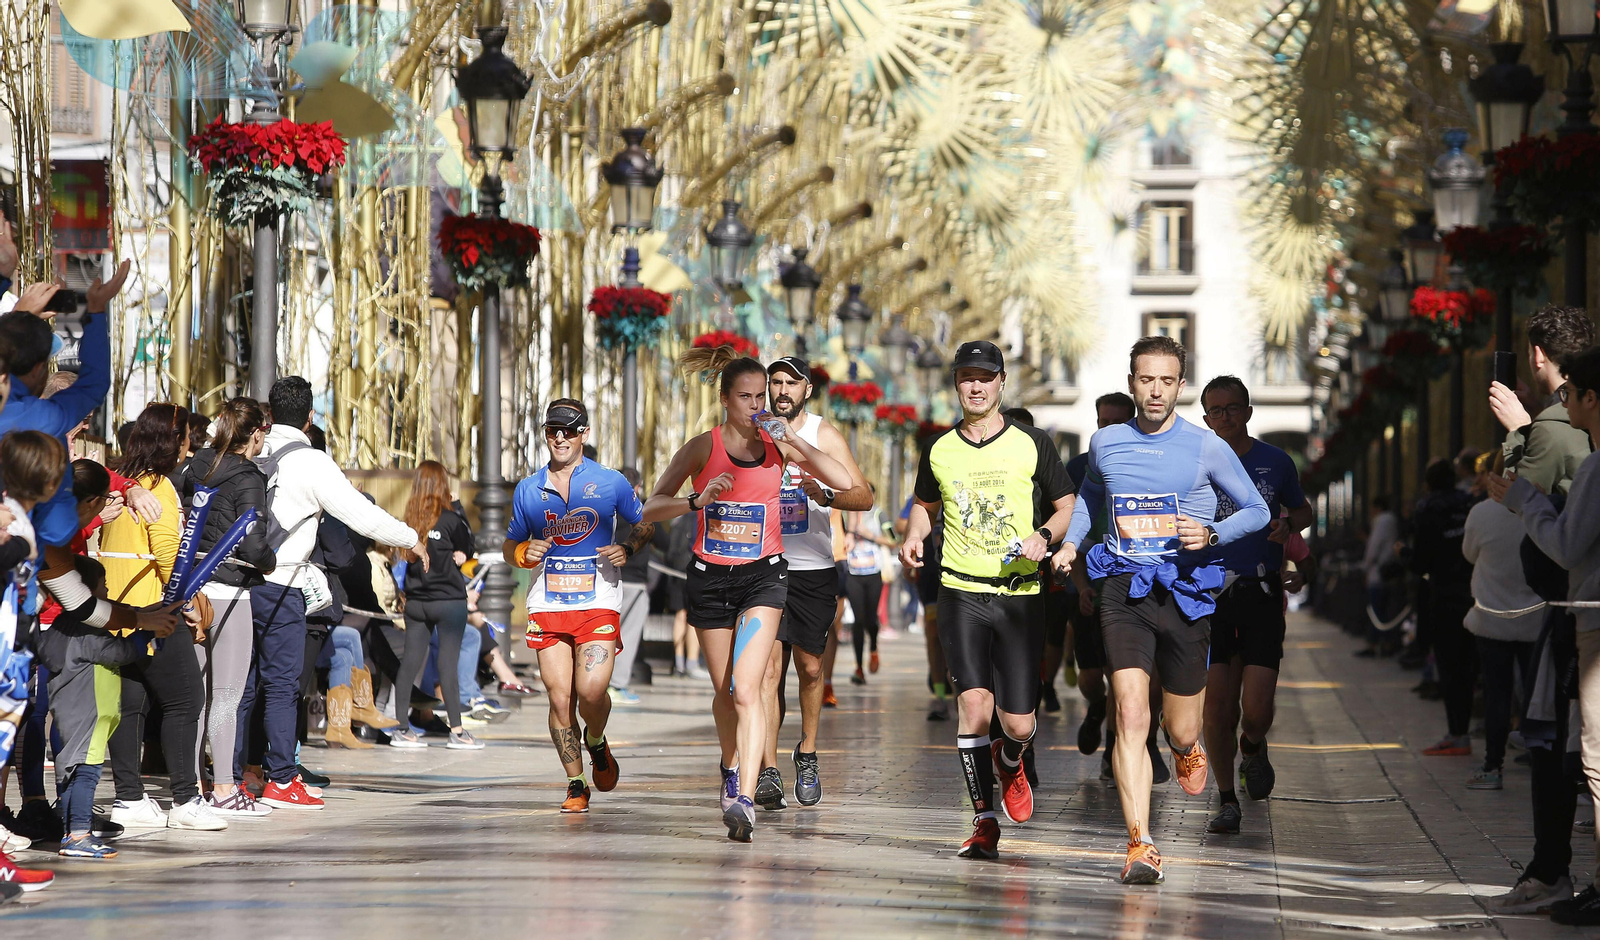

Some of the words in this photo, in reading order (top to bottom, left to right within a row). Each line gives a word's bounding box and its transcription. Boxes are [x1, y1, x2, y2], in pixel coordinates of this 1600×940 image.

[728, 508, 753, 516] ZURICH
[779, 506, 793, 514] 19
[557, 515, 587, 526] CARNICAS
[1133, 517, 1160, 530] 1711
[178, 511, 200, 559] ZURICH
[542, 521, 589, 538] COVIHER
[720, 523, 747, 535] 2207
[558, 576, 582, 586] 2179
[162, 572, 182, 606] RICH
